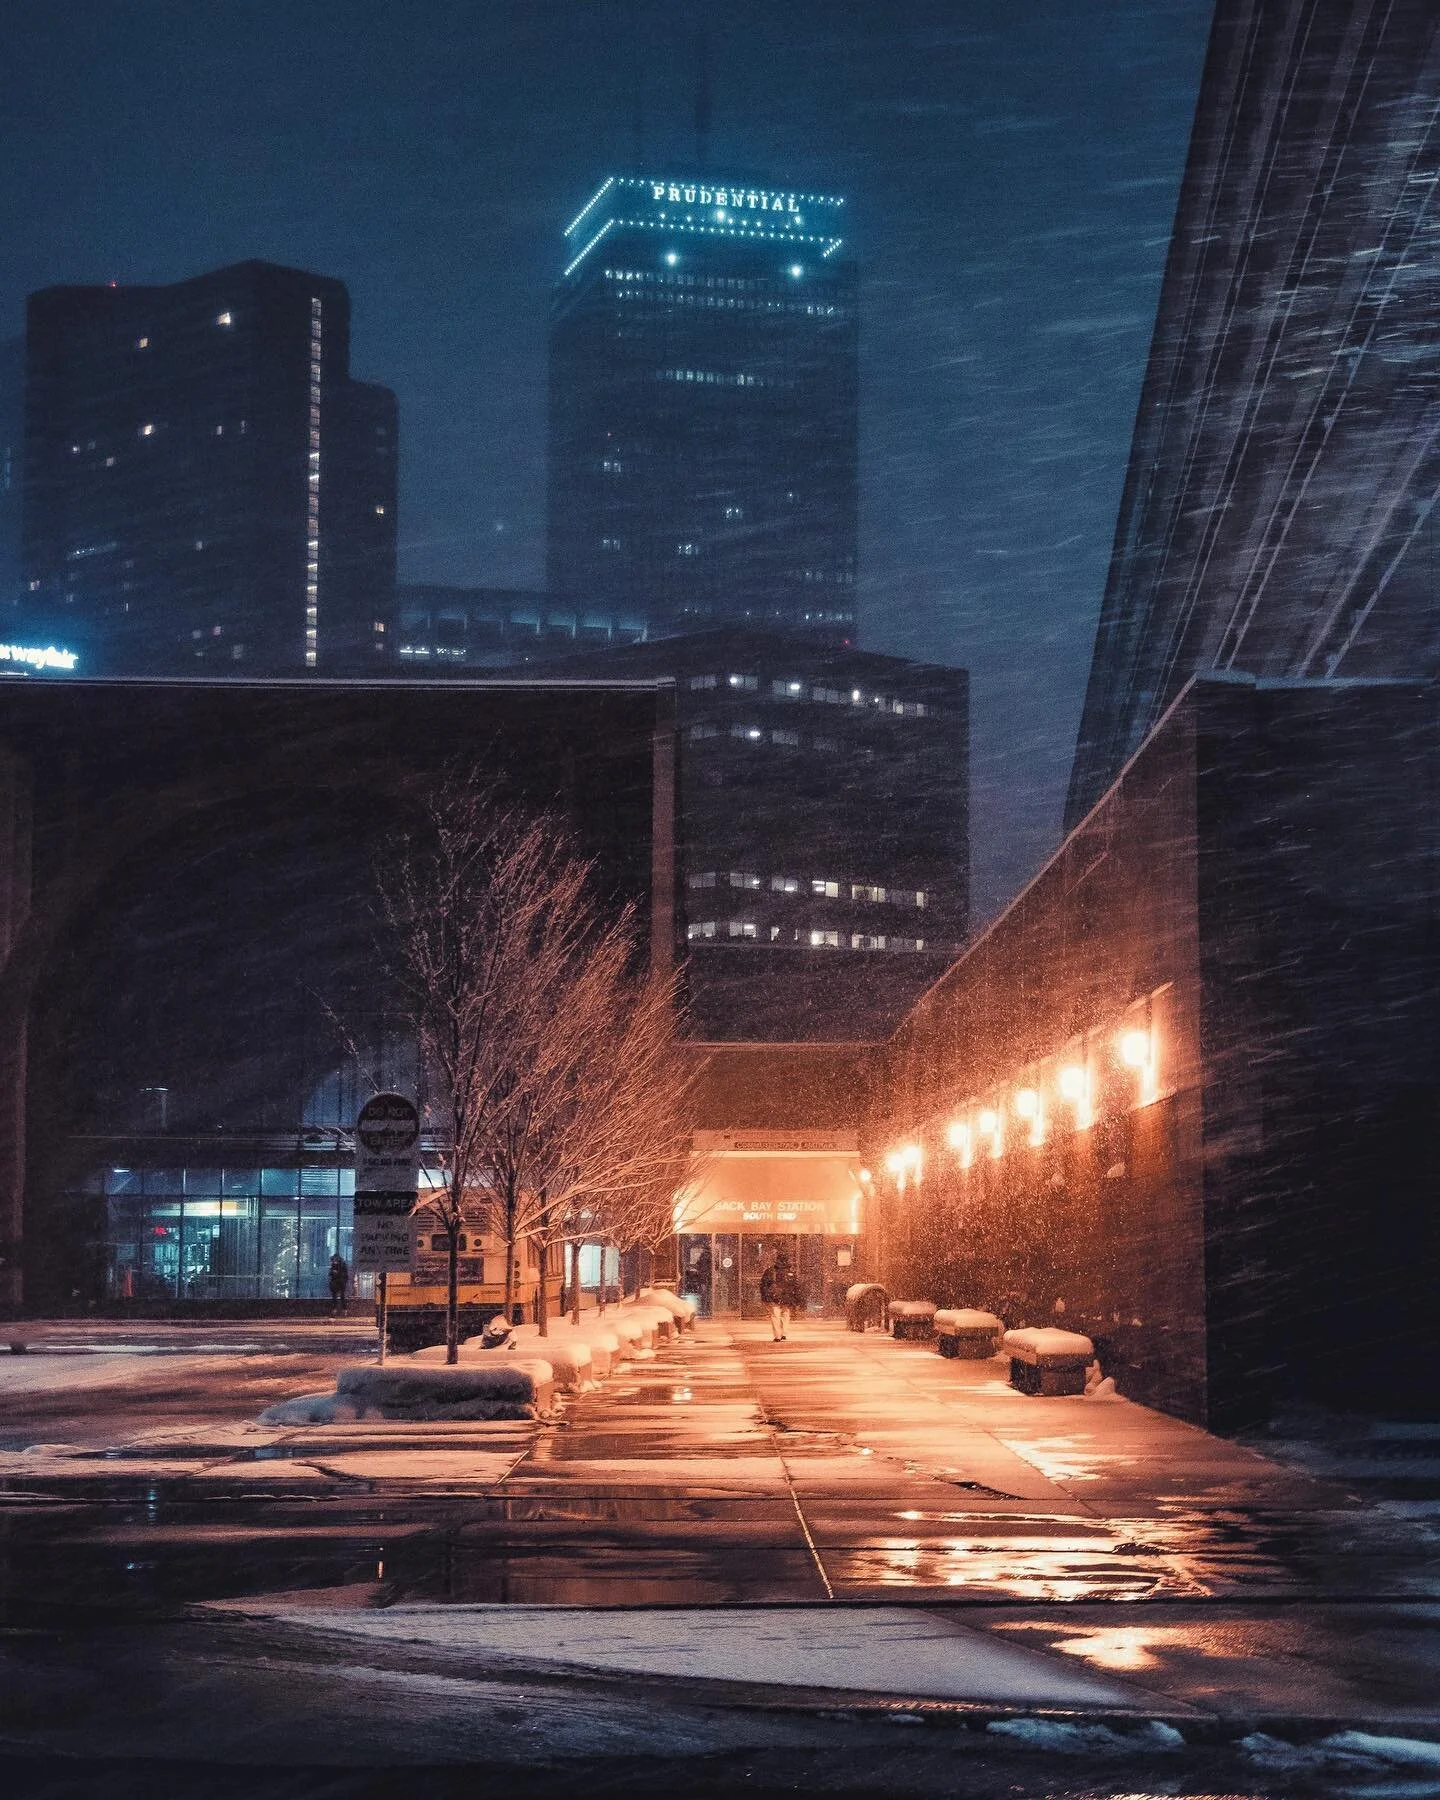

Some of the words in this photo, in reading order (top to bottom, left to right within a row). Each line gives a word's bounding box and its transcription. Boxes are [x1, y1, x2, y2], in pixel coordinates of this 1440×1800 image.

[653, 186, 799, 212] PRUDENTIAL
[368, 1107, 385, 1117] DO
[388, 1107, 410, 1117] NOT
[358, 1199, 381, 1209] TOW
[386, 1199, 415, 1209] AREA
[750, 1201, 772, 1211] BAY
[778, 1201, 825, 1211] STATION
[742, 1211, 773, 1220] SOUTH
[377, 1220, 393, 1229] NO
[360, 1233, 409, 1242] PARKING
